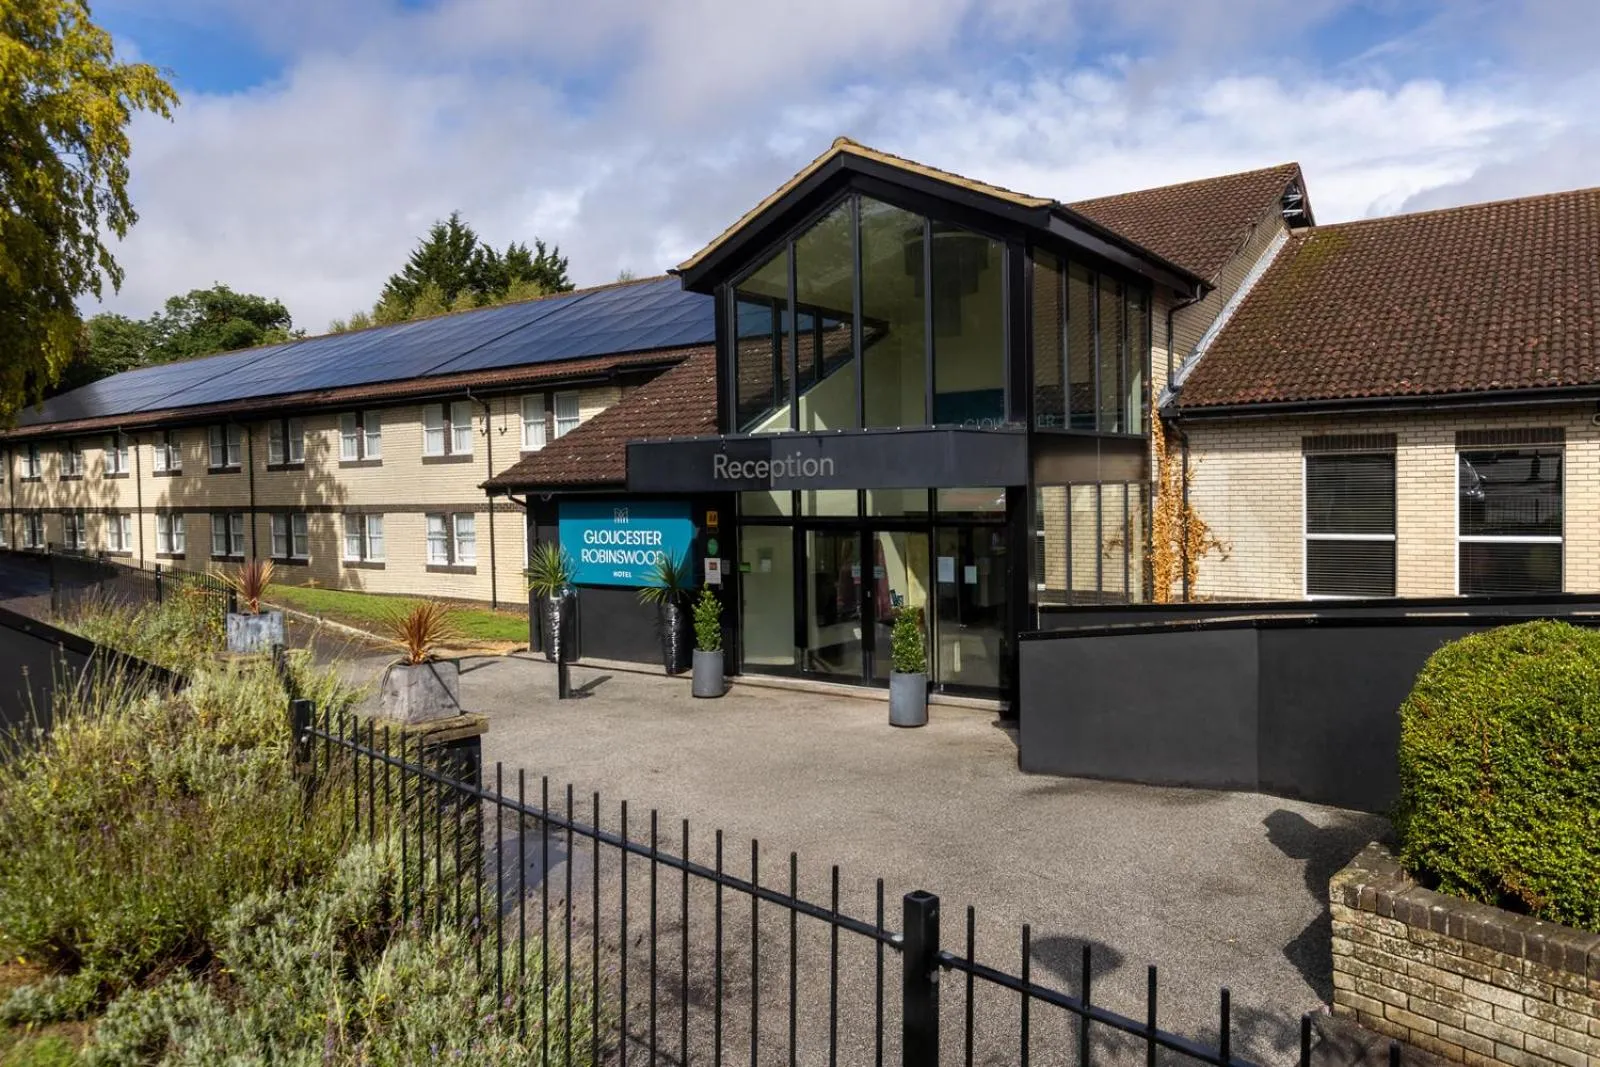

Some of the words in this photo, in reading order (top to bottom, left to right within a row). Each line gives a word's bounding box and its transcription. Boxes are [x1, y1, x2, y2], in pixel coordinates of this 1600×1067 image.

[713, 450, 834, 487] Reception
[583, 529, 662, 545] GLOUCESTER
[581, 548, 665, 566] ROBINSWOOD
[613, 571, 632, 579] HOTEL
